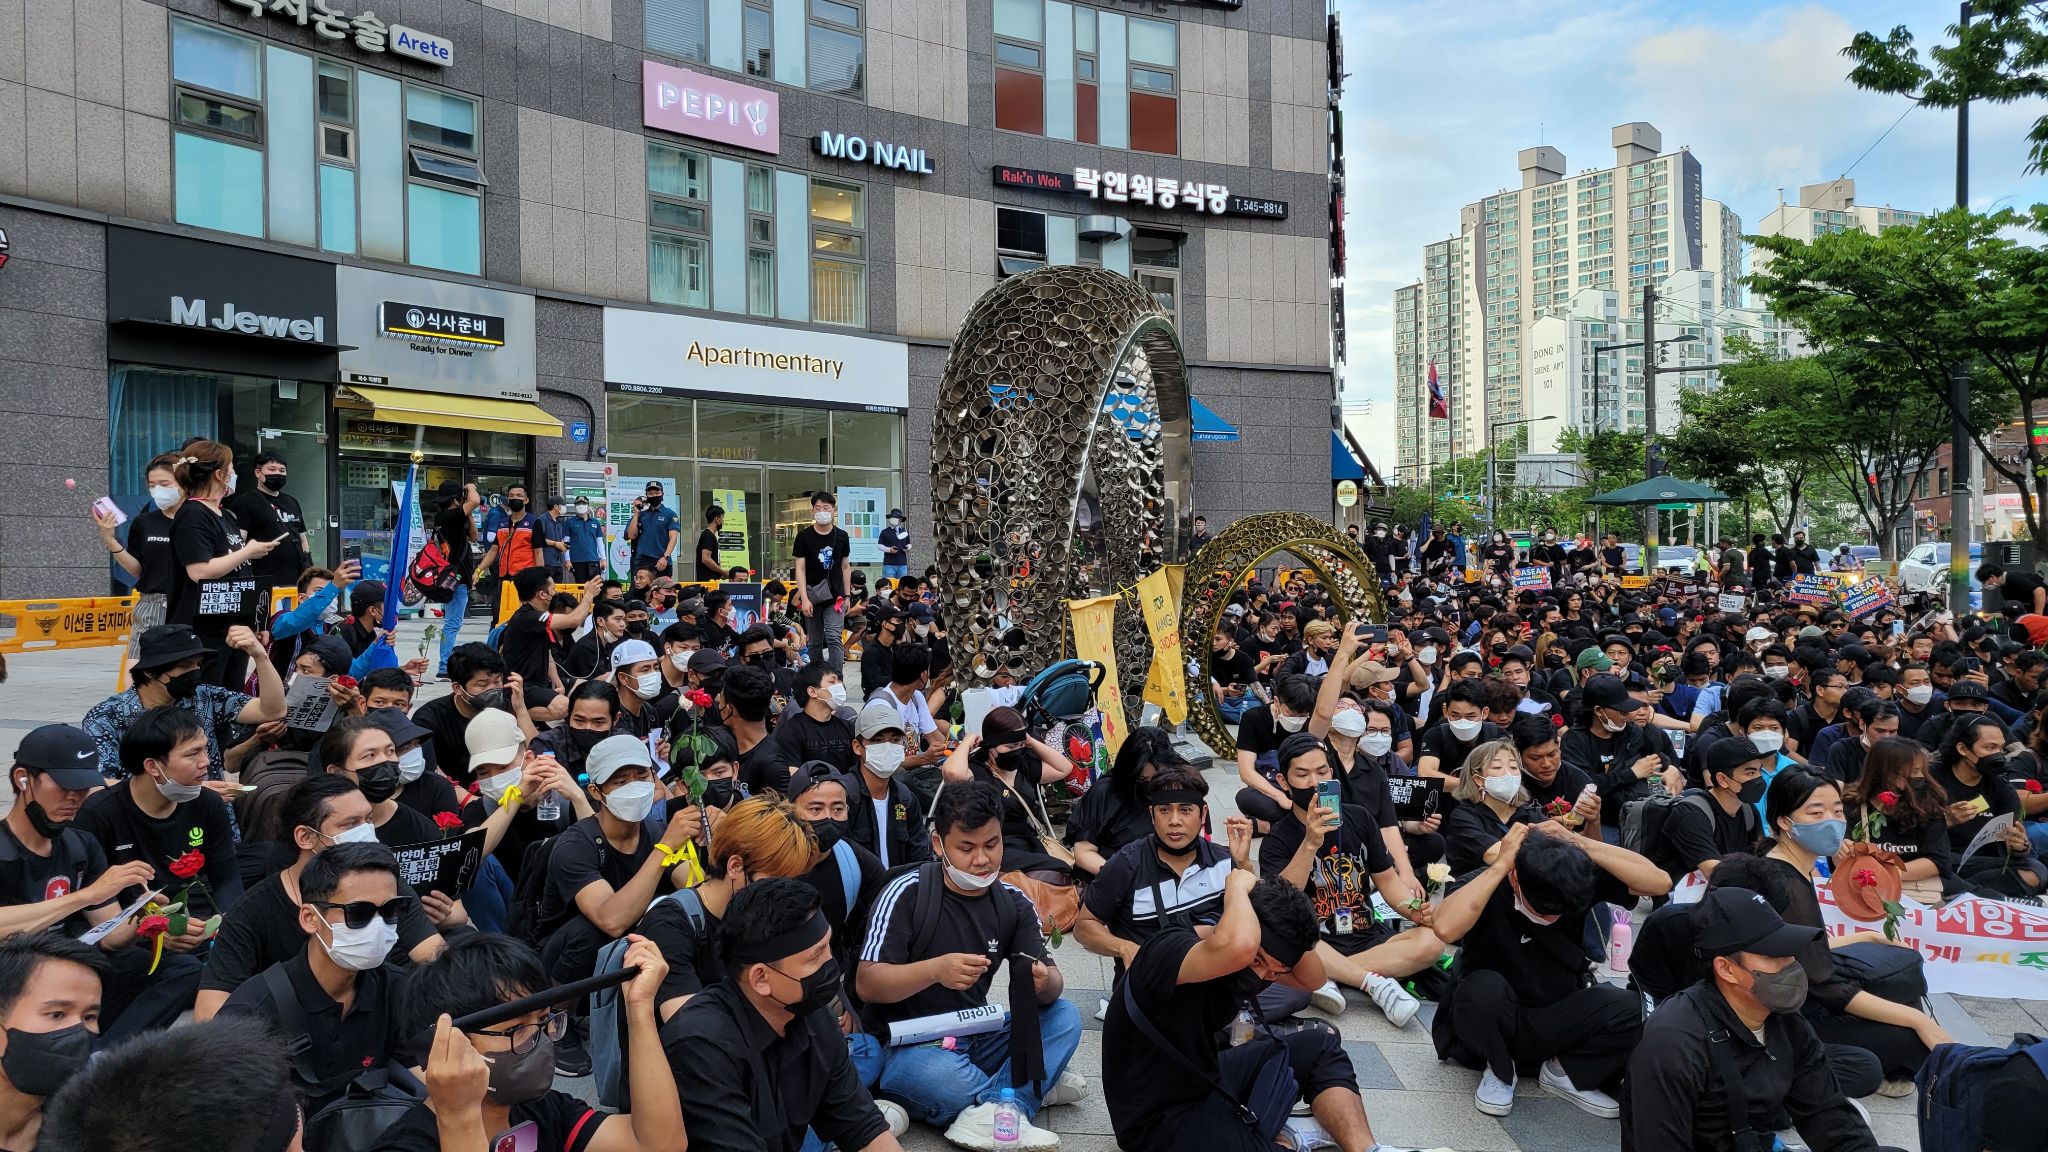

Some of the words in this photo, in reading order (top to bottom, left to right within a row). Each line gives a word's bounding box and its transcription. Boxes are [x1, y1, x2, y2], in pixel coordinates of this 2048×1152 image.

[397, 31, 449, 60] Arete
[658, 82, 741, 126] PEPI
[820, 130, 868, 162] MO
[872, 139, 934, 175] NAIL
[1002, 169, 1034, 185] Rak'n
[1037, 173, 1062, 189] Wok
[1073, 167, 1230, 215] 락앤웍중식당
[1234, 198, 1284, 215] T.545-8814
[170, 296, 207, 328] M
[211, 302, 324, 343] Jewel
[426, 312, 487, 336] 식사준비
[410, 342, 435, 355] Ready
[436, 344, 448, 354] for
[448, 347, 474, 358] Dinner
[1533, 346, 1554, 360] DONG
[1556, 344, 1565, 354] IN
[686, 340, 844, 380] Apartmentary
[1553, 361, 1565, 371] APT
[1521, 567, 1548, 577] ASEAN
[1804, 575, 1838, 586] ASEAN
[202, 581, 230, 593] 미얀마
[231, 580, 256, 592] 군부의
[1848, 576, 1881, 598] ASEAN
[201, 593, 220, 603] 사형
[223, 592, 241, 602] 집행
[1851, 593, 1880, 610] DENYING
[64, 612, 95, 633] 이선을
[1387, 777, 1403, 787] 얀마
[1405, 779, 1427, 789] 군부의
[429, 840, 462, 858] 군부의
[1883, 841, 1918, 854] Green
[415, 856, 440, 872] 집행
